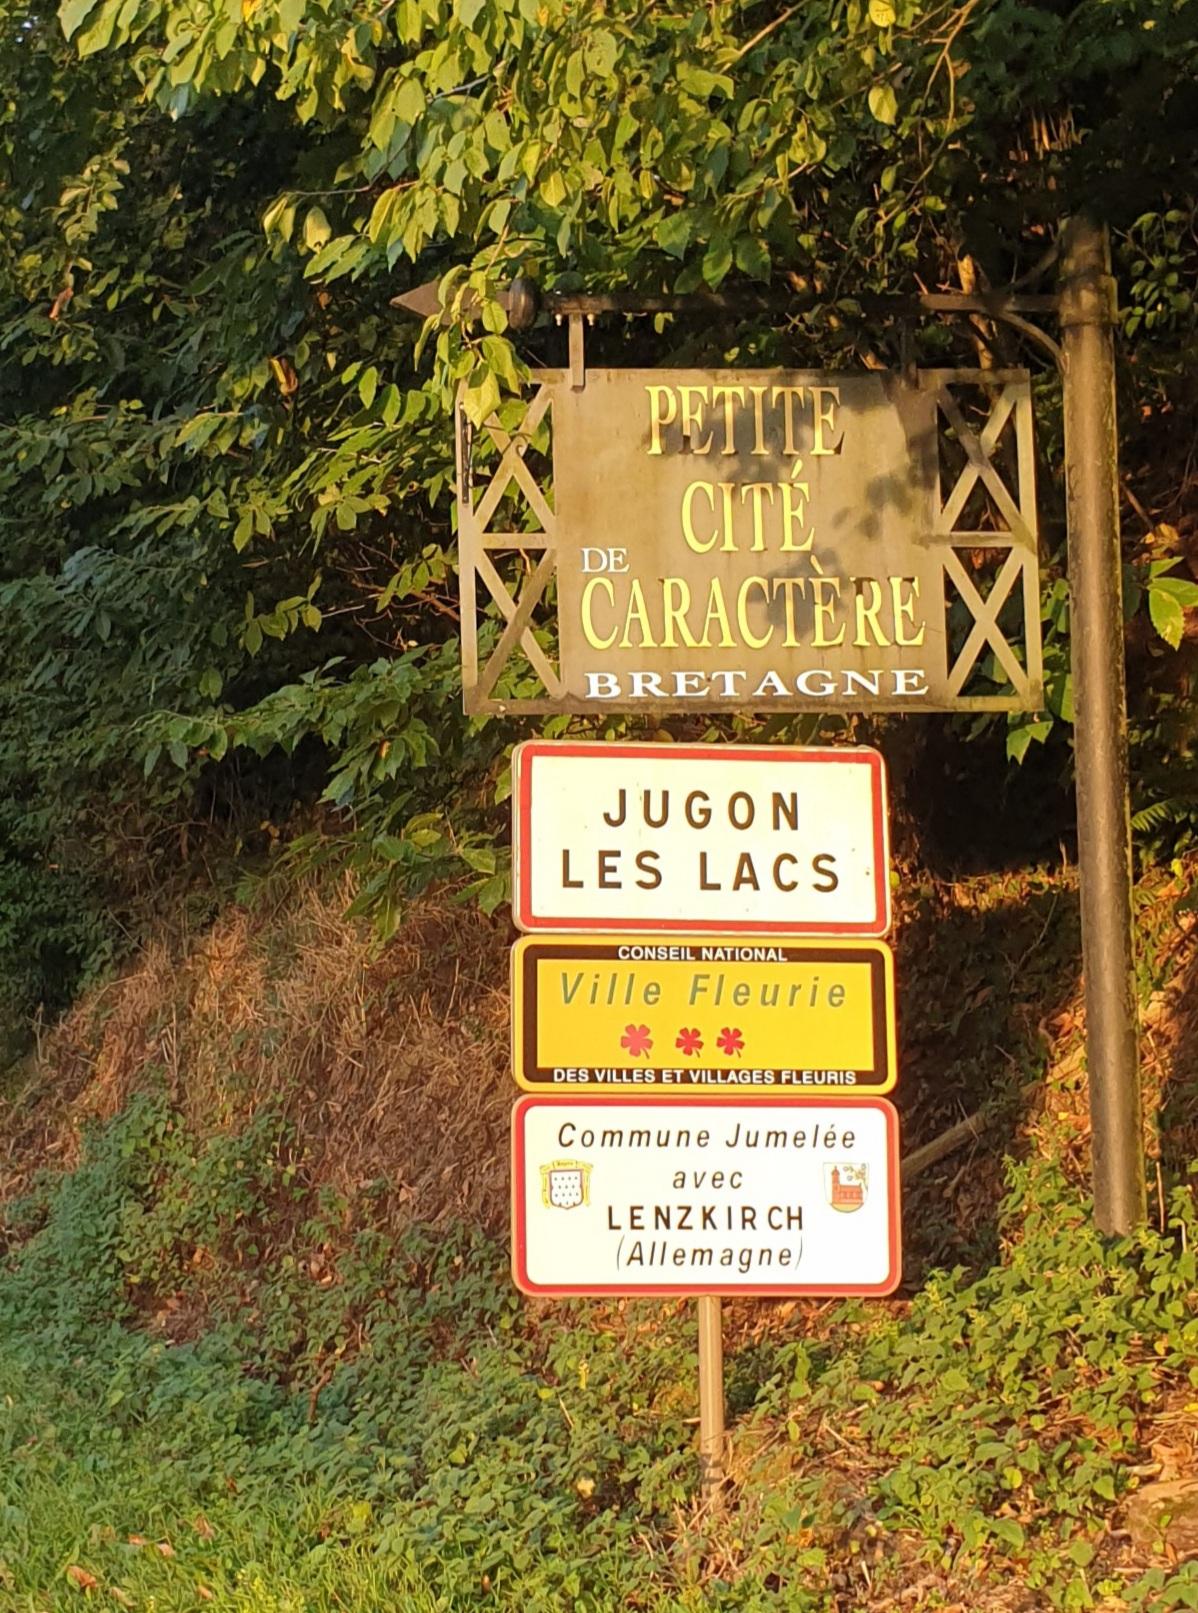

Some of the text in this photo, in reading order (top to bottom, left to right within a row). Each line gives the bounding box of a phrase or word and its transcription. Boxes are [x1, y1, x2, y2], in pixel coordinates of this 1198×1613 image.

[645, 385, 844, 456] PETITE
[681, 459, 815, 553] CITÉ
[581, 547, 629, 573] DE
[581, 555, 927, 650] CARACTÈRE
[585, 669, 928, 698] BRETAGNE
[603, 789, 798, 830] JUGON
[562, 849, 839, 892] LES LACS
[618, 946, 788, 962] CONSEIL NATIONAL
[560, 972, 846, 1008] Ville Fleurie
[553, 1068, 856, 1085] DES VILLES ET VILLAGES FLEURIS
[558, 1122, 856, 1149] Commune Jumelée
[672, 1167, 743, 1189] avec
[607, 1205, 803, 1230] LENZKIRCH
[616, 1235, 803, 1273] (Allemagne)
